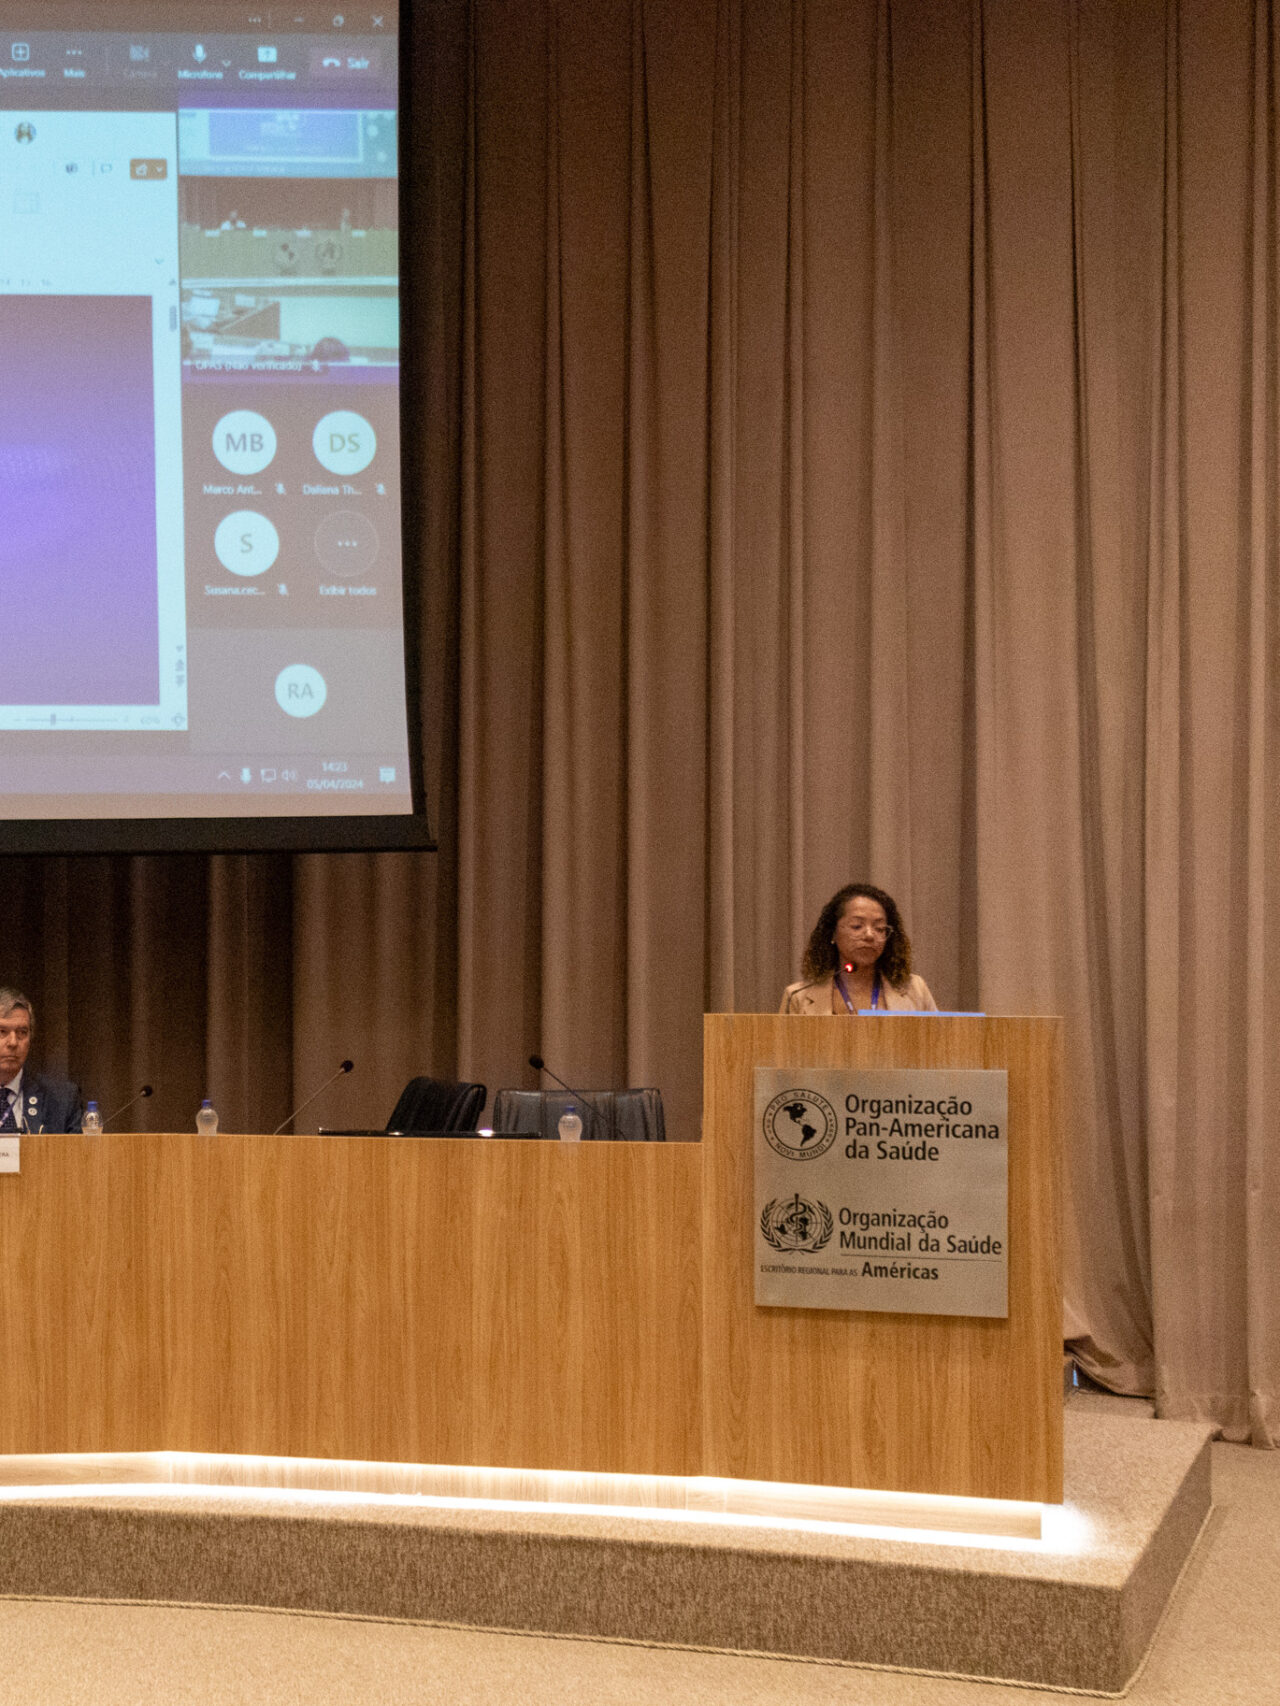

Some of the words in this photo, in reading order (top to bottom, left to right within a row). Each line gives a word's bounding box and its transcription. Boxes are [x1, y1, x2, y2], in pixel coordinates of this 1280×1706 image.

[347, 57, 370, 69] Sair
[64, 68, 86, 79] Mais
[177, 69, 223, 81] Microfone
[238, 69, 297, 82] Compartilhar
[225, 432, 264, 453] MB
[329, 433, 361, 453] DS
[203, 484, 234, 496] Marco
[240, 534, 254, 553] S
[348, 585, 377, 597] todos
[286, 682, 315, 700] RA
[306, 778, 364, 790] 05/04/2024
[845, 1094, 972, 1120] Organização
[845, 1117, 1000, 1140] Pan-Americana
[845, 1139, 869, 1160] da
[877, 1140, 939, 1161] Saúde
[838, 1207, 949, 1234] Organização
[839, 1231, 911, 1252] Mundial
[918, 1233, 940, 1254] da
[946, 1234, 1002, 1255] Saúde
[798, 1266, 829, 1275] REGIONAL
[831, 1268, 848, 1276] PARA
[861, 1261, 939, 1281] Américas
